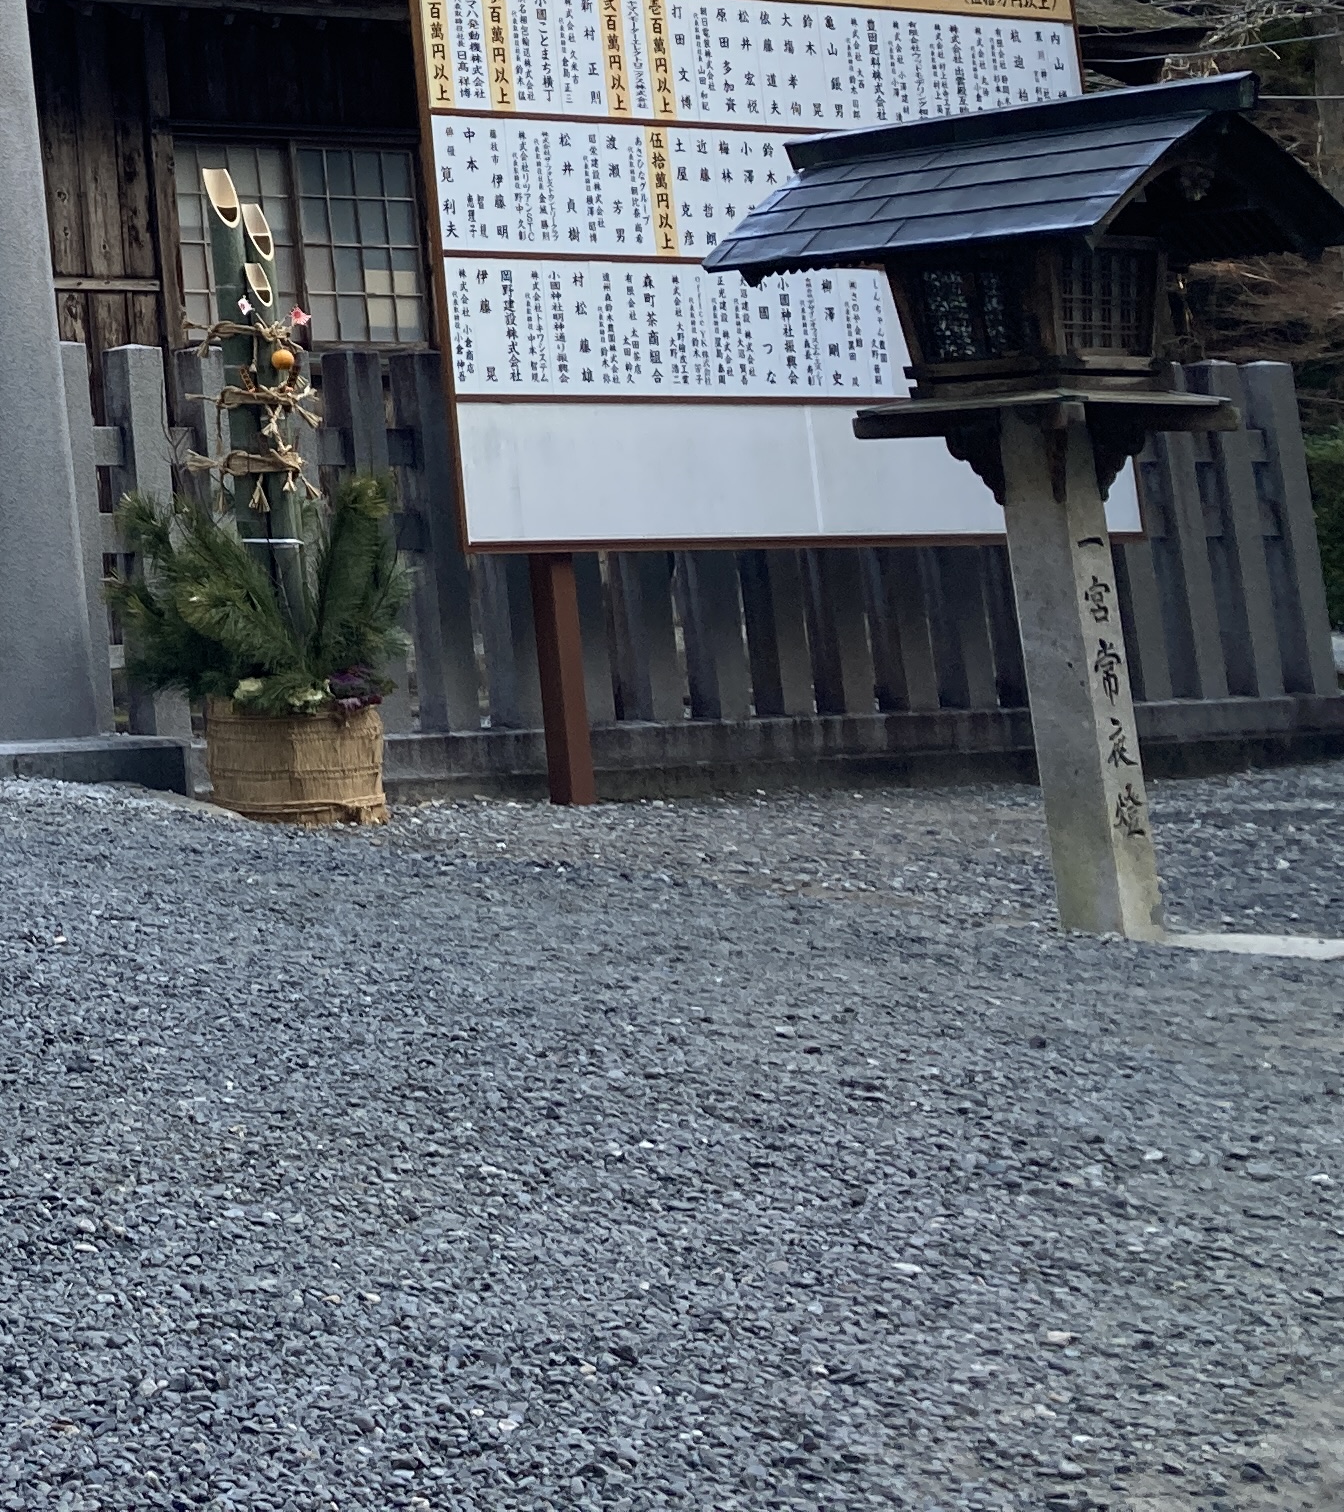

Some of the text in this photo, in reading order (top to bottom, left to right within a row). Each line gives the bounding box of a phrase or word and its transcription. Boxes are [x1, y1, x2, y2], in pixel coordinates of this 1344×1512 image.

[463, 127, 479, 173] 中本
[650, 132, 674, 250] 伍拾萬円以上
[763, 142, 778, 184] 鈴木
[501, 270, 523, 382] 岡野建設株式会社
[643, 273, 664, 384] 森町茶商組合
